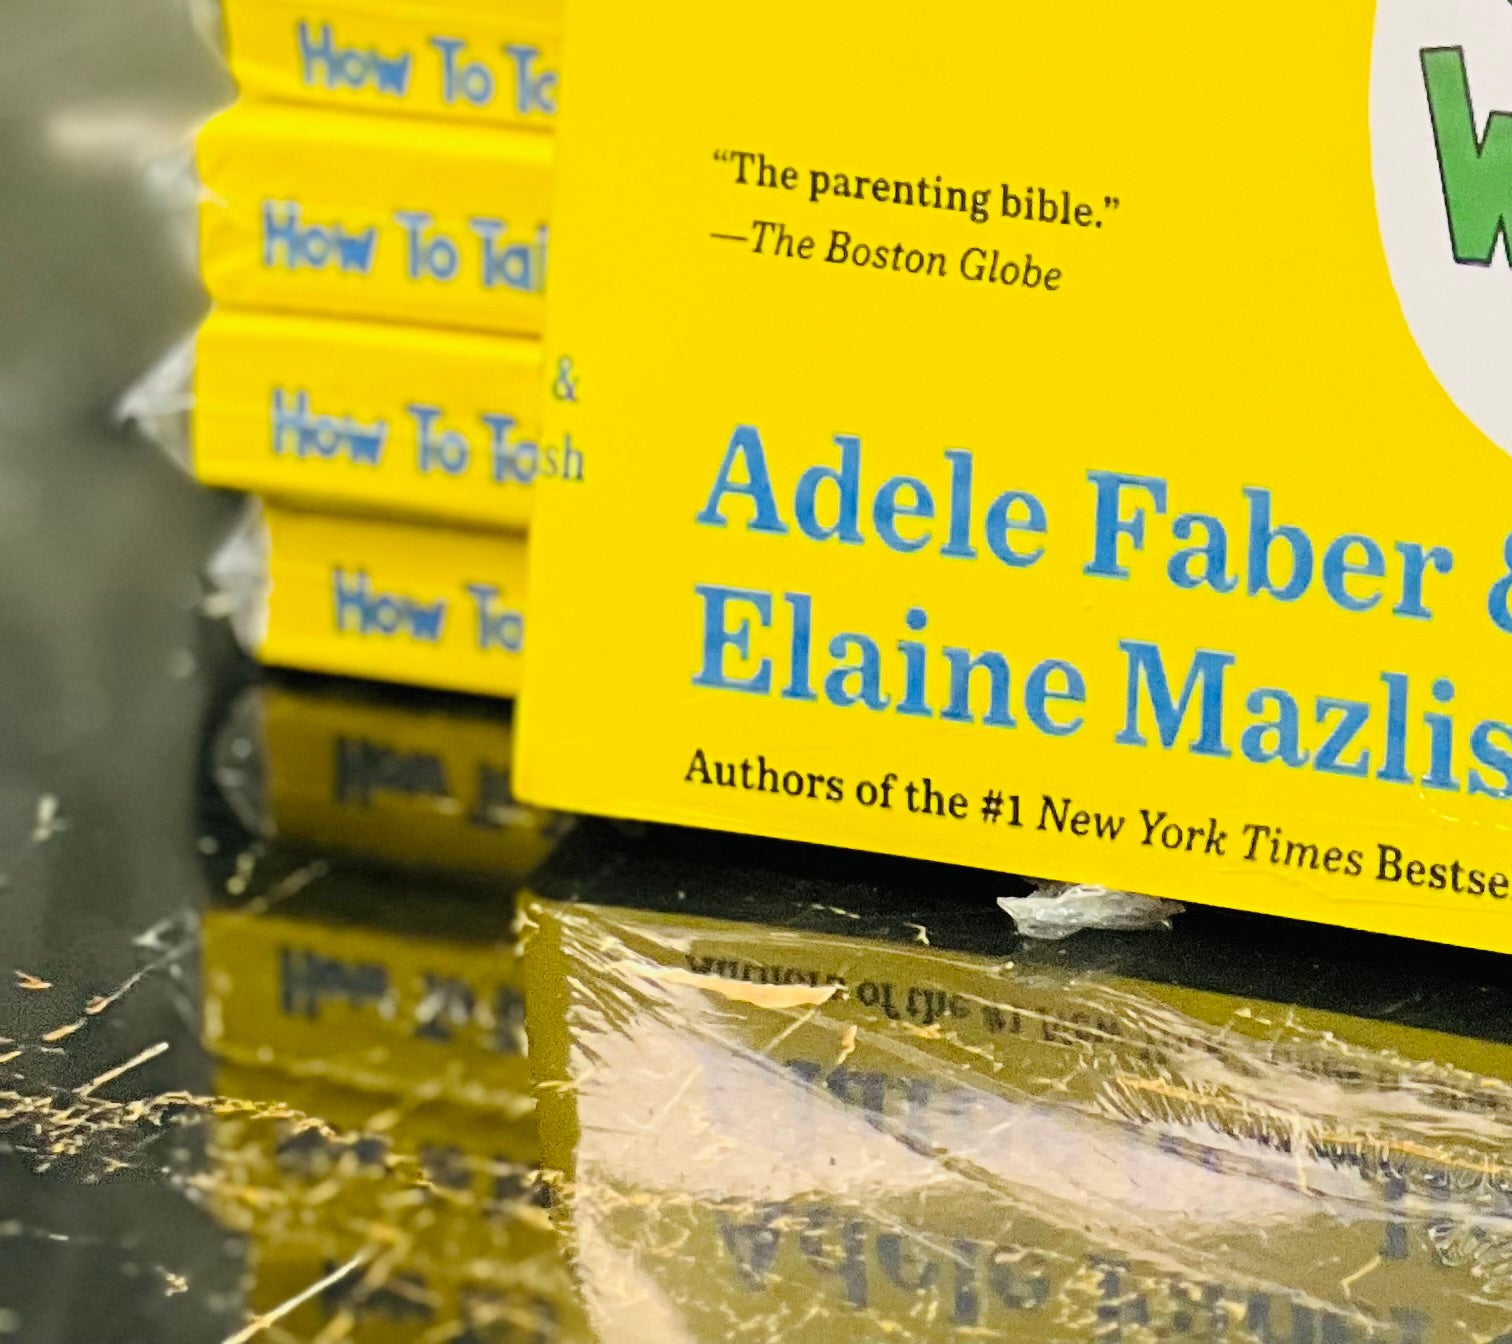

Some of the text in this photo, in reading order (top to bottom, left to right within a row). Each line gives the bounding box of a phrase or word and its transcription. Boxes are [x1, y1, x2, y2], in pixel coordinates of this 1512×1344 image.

[296, 20, 412, 98] How
[430, 34, 495, 105] To
[809, 167, 992, 225] parenting
[261, 198, 379, 275] How
[395, 210, 461, 283] To
[824, 229, 948, 277] Boston
[959, 246, 1063, 292] Globe
[269, 388, 388, 466] How
[407, 403, 471, 476] To
[695, 422, 1049, 568] Adele
[1083, 468, 1454, 621] Faber
[331, 566, 446, 643] How
[690, 582, 1088, 737] Elaine
[684, 747, 844, 803] Authors
[855, 772, 898, 808] of
[904, 777, 969, 820] the
[981, 787, 1022, 828] #1
[1036, 794, 1125, 842] New
[1137, 809, 1227, 857] York
[1241, 823, 1364, 878] Times
